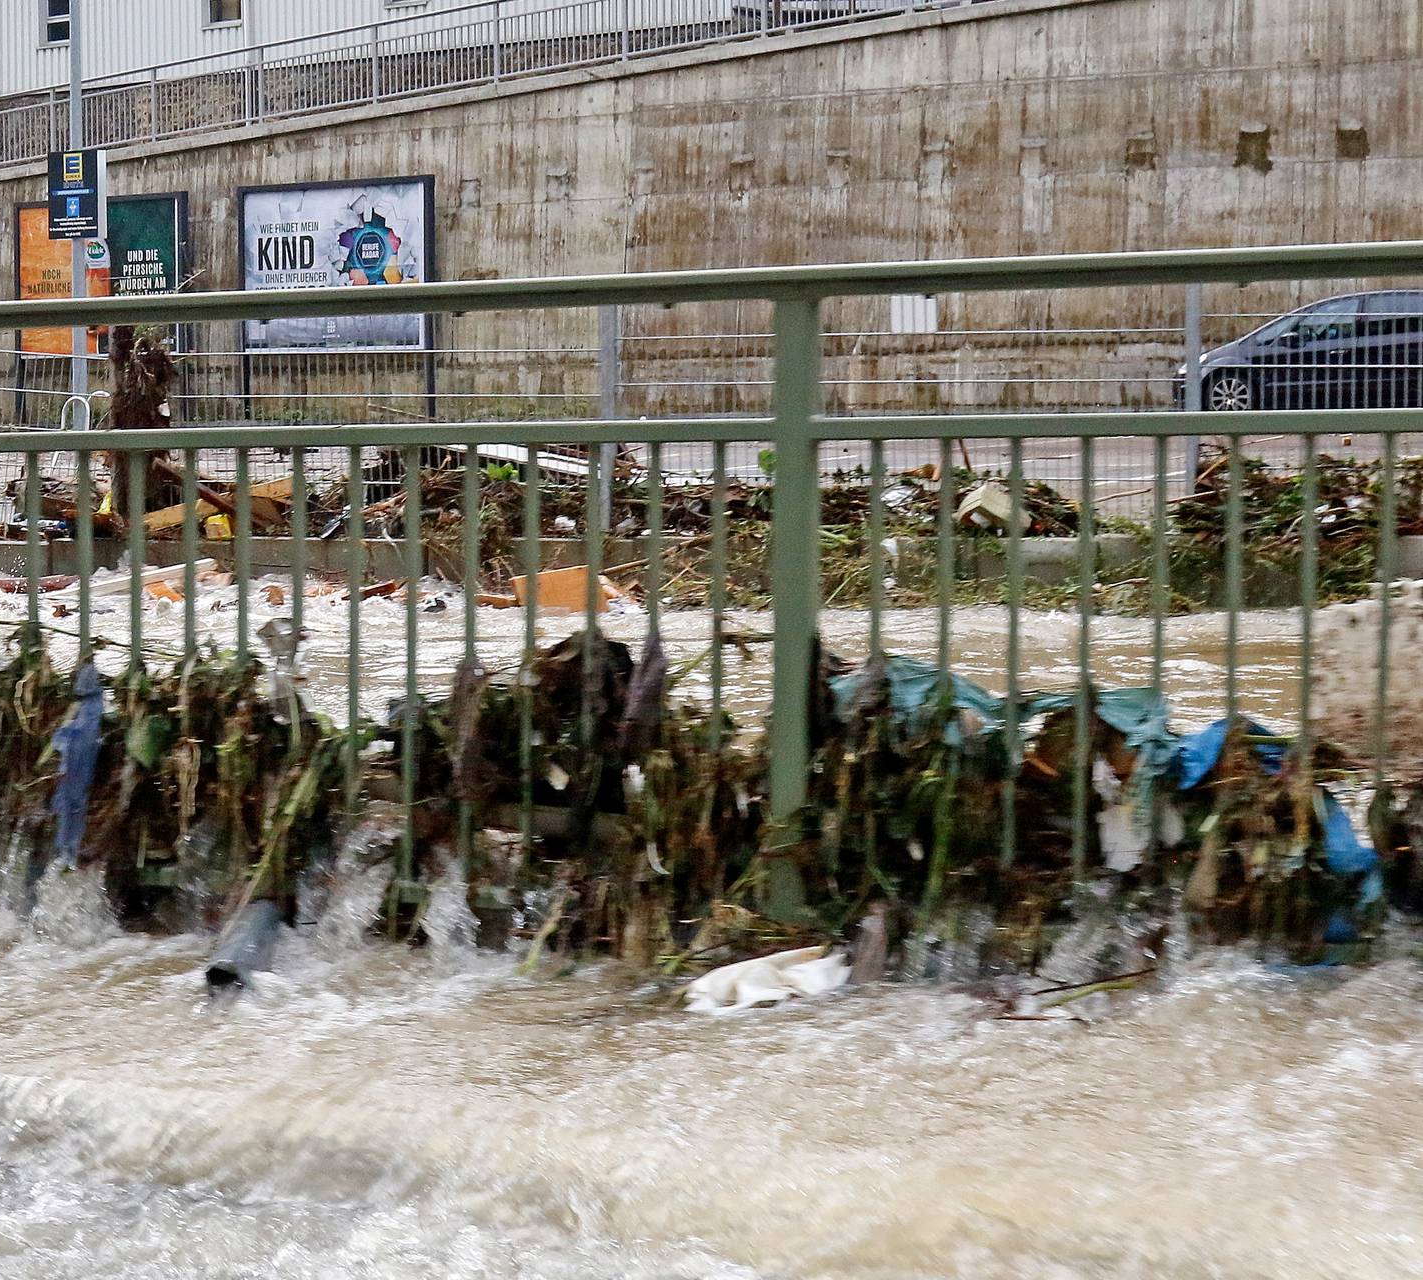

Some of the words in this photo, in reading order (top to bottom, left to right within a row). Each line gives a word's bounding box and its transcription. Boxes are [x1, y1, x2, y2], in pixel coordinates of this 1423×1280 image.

[260, 224, 273, 234] WIE
[275, 223, 298, 233] FINDET
[301, 221, 319, 231] MEIN
[128, 250, 143, 262] UND
[146, 249, 158, 261] DIE
[258, 235, 315, 271] KIND
[362, 251, 379, 259] RADAR
[42, 270, 61, 279] NOCH
[123, 263, 163, 276] PFIRSICHE
[120, 278, 152, 290] WÜRDEN
[155, 277, 166, 289] AM
[265, 274, 284, 284] OHNE
[286, 272, 327, 283] INFLUENCER
